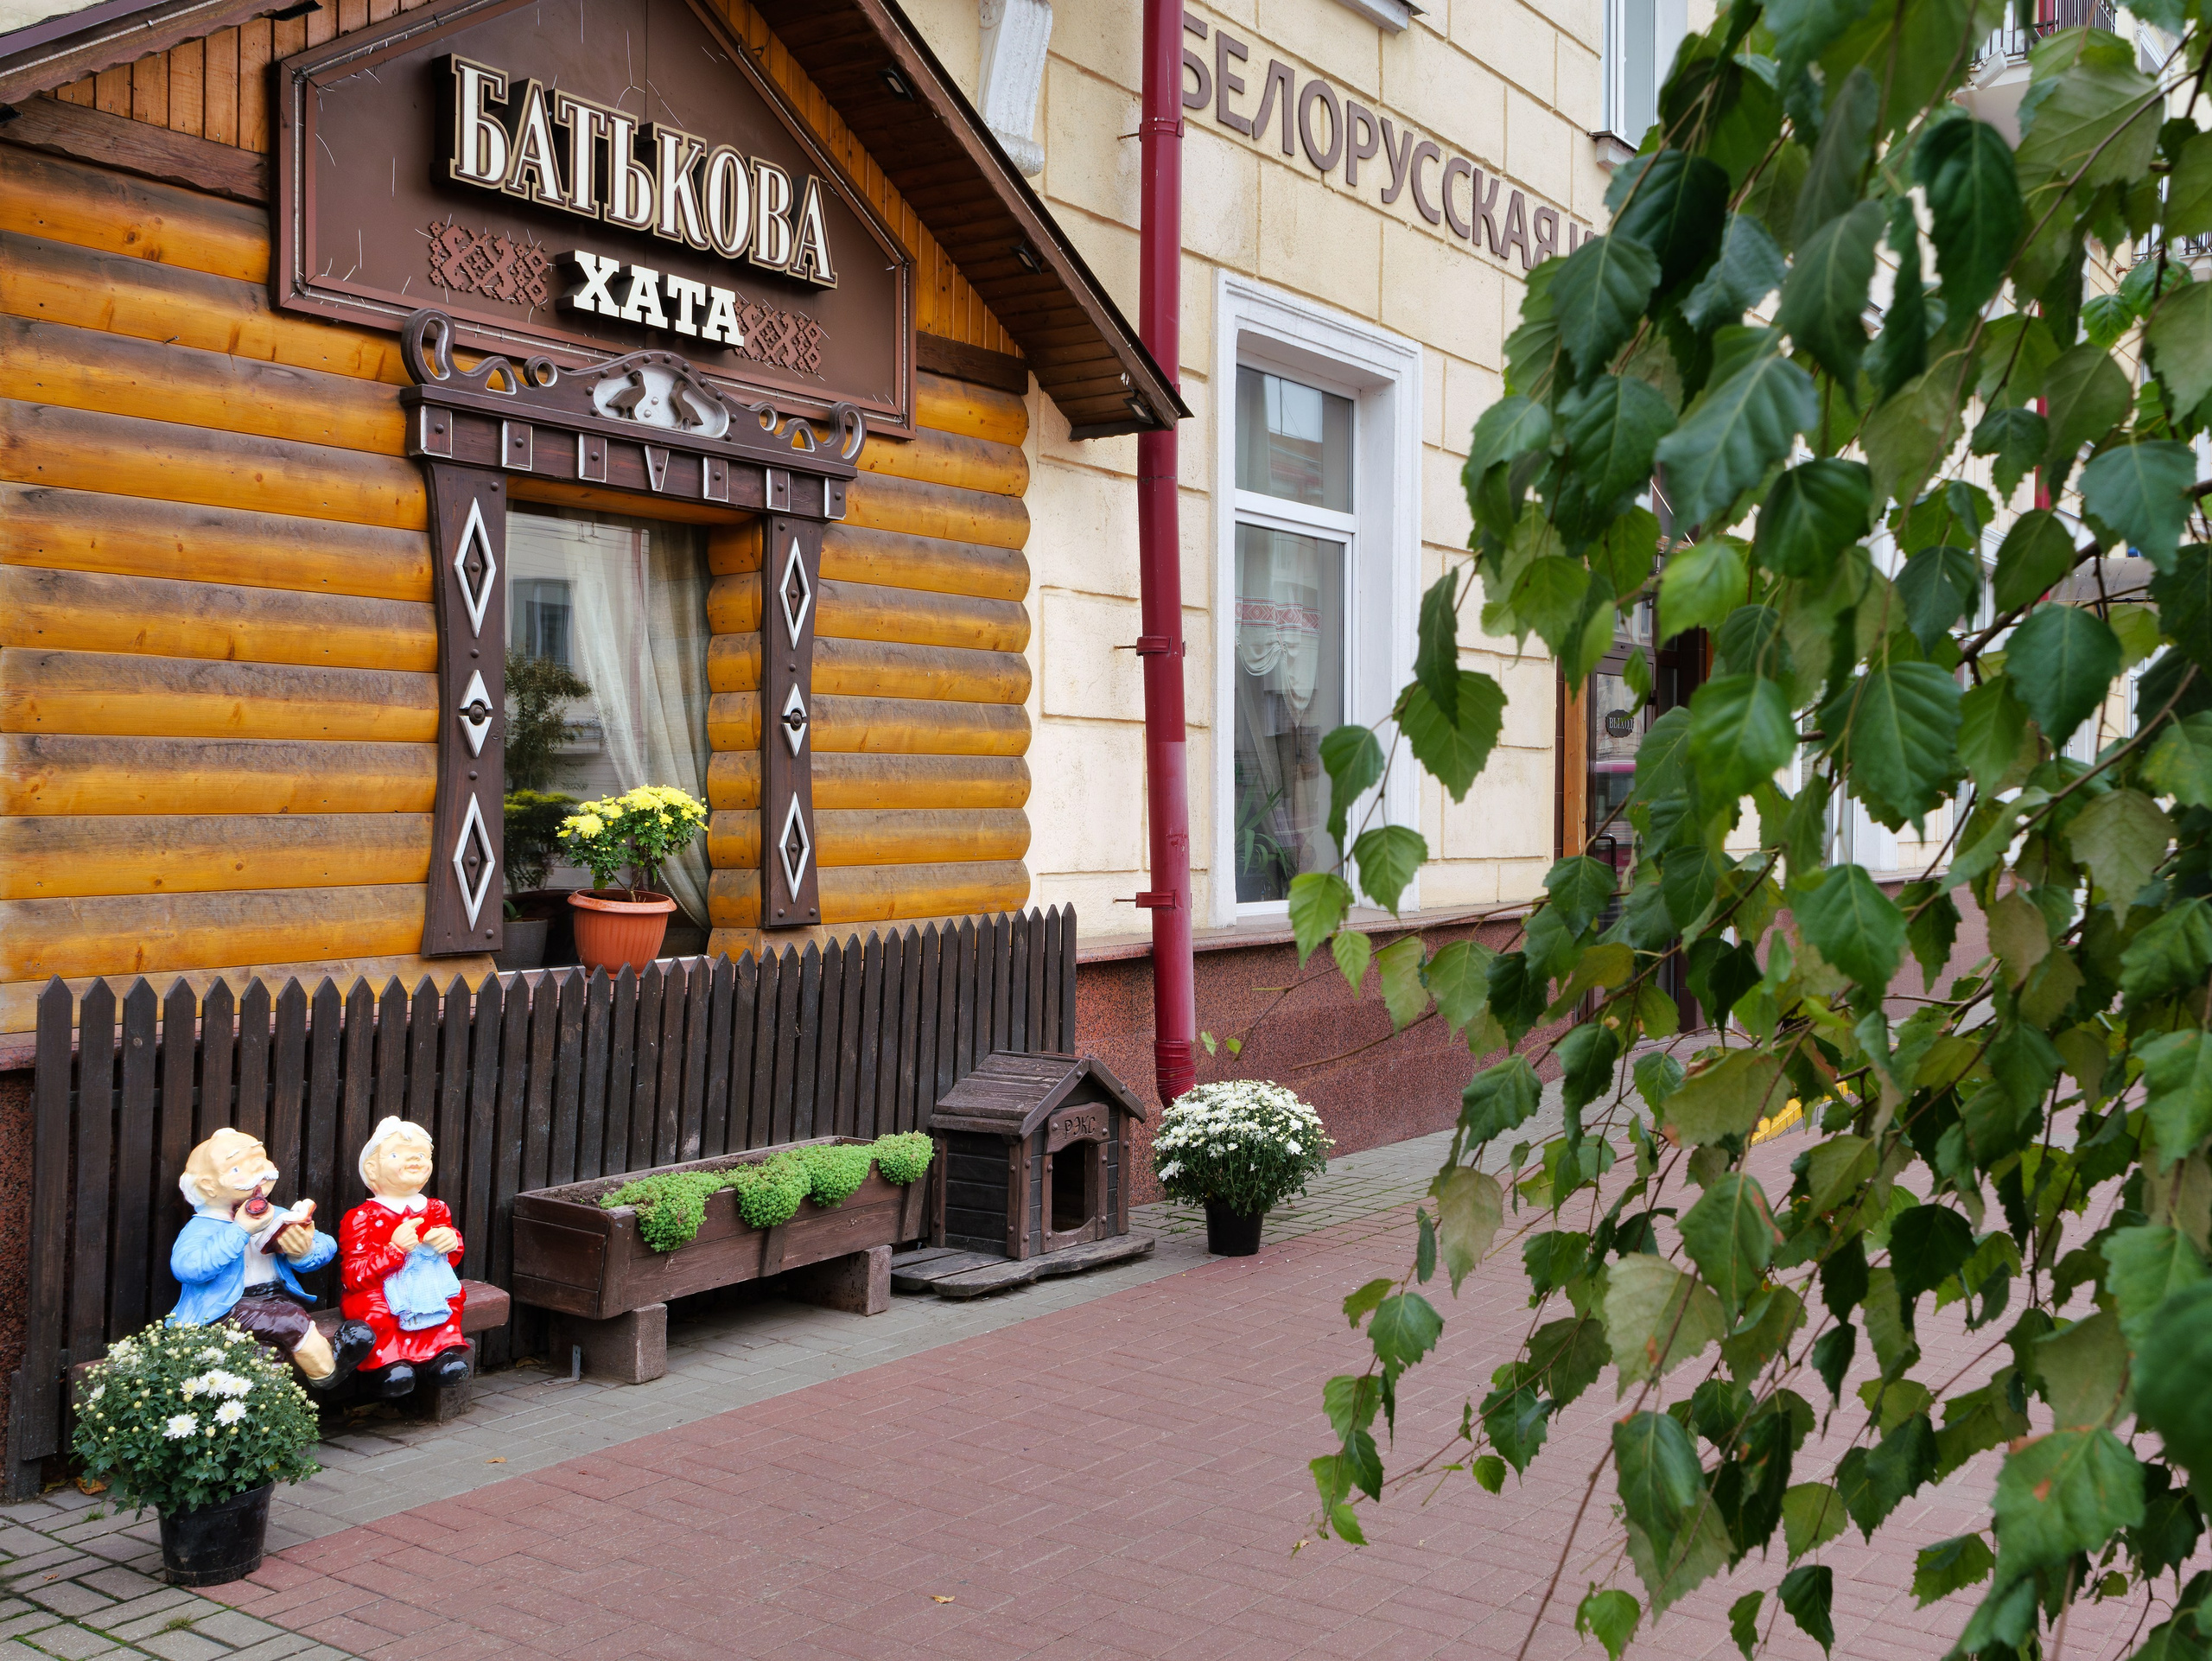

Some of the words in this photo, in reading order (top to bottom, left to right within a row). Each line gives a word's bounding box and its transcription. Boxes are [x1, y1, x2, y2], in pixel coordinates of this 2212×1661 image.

[448, 52, 838, 290] БАТЬКОВА
[1182, 10, 1560, 270] БЕЛОРУССКАЯ
[572, 249, 745, 348] ХАТА
[1064, 1115, 1096, 1139] РЭКС
